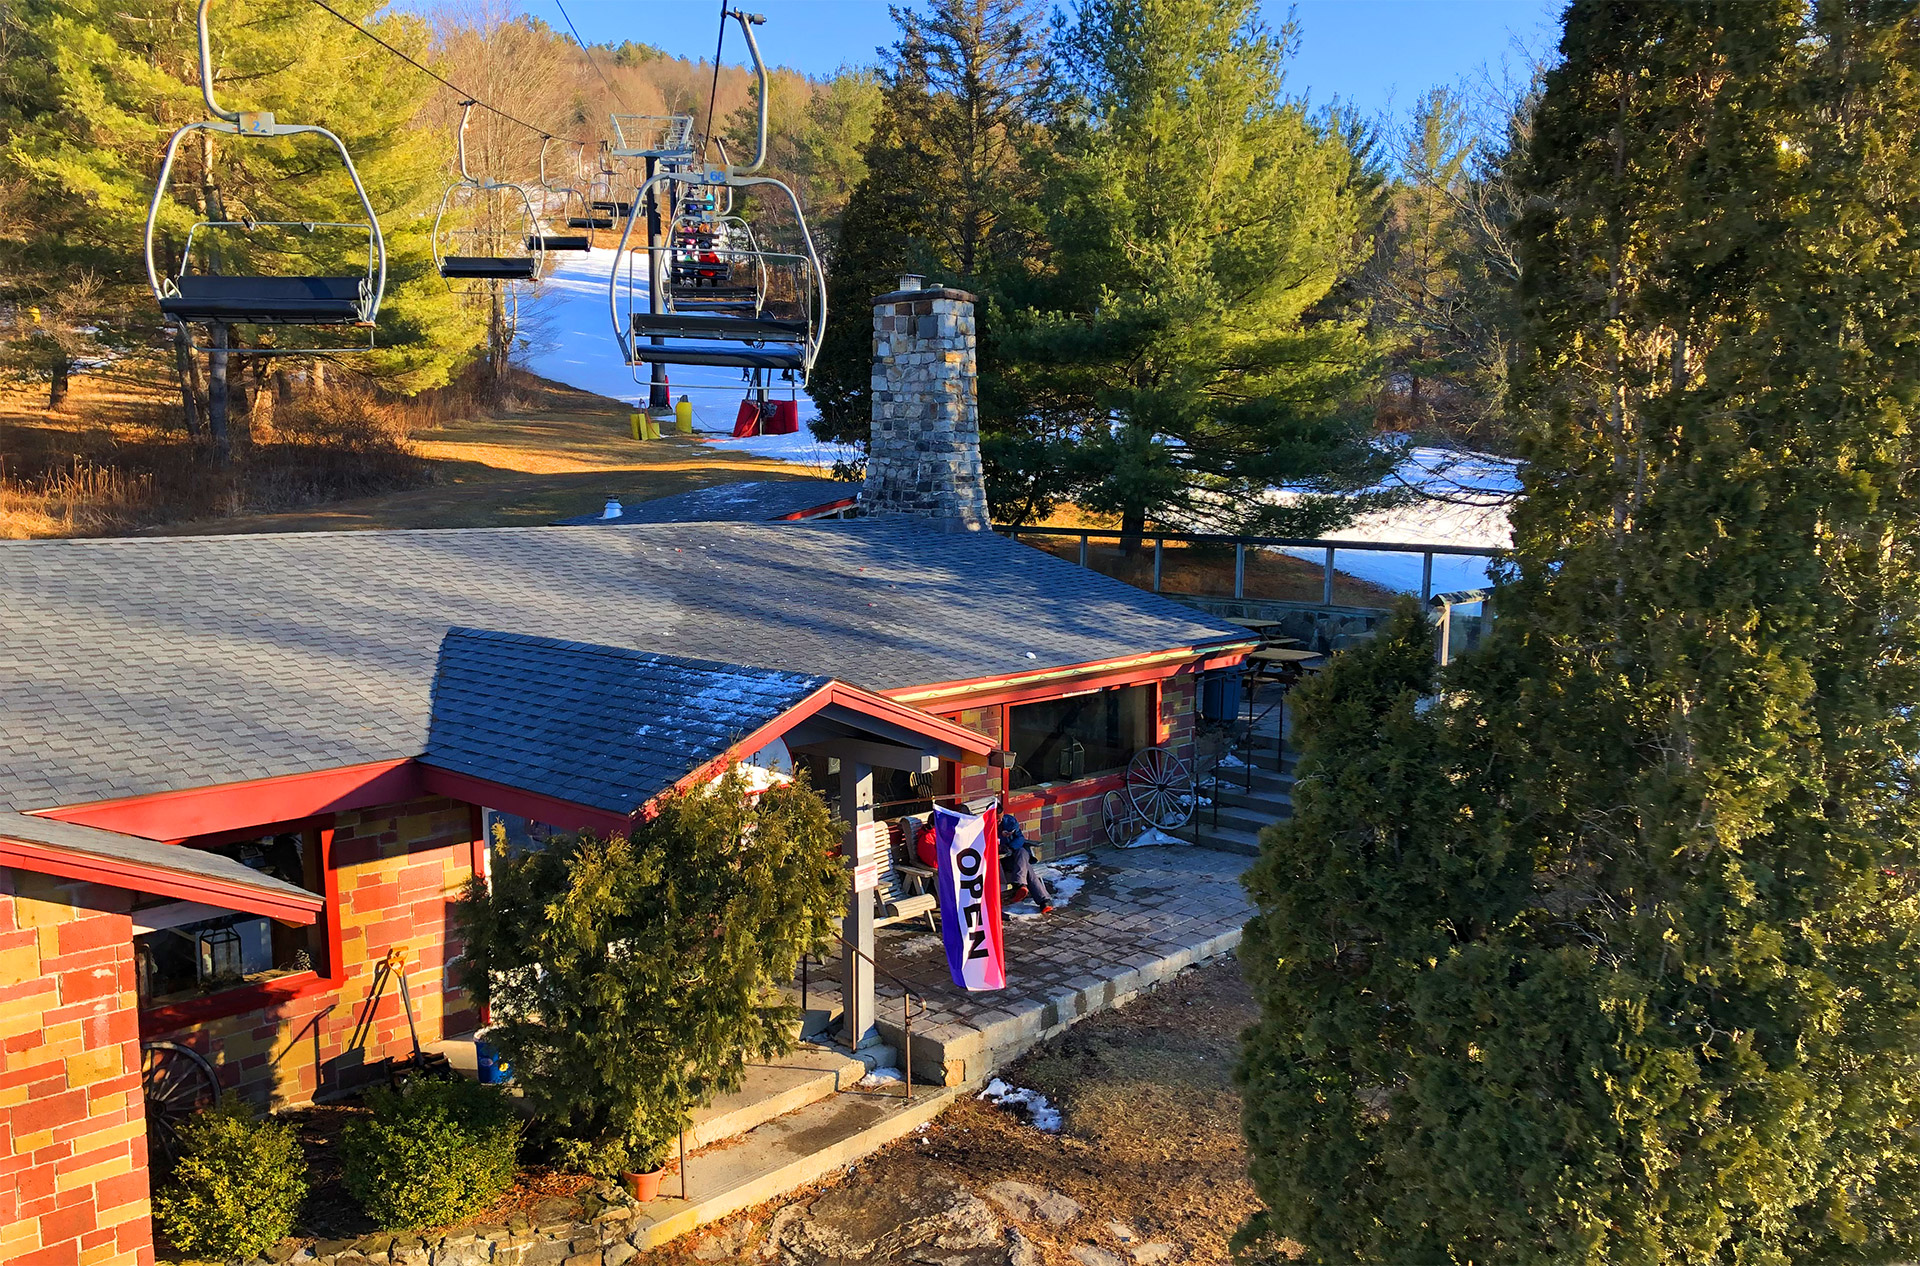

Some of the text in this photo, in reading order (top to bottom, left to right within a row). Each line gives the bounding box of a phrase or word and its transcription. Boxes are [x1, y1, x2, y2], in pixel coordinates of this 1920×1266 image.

[252, 120, 260, 132] 2
[710, 170, 726, 182] 68
[956, 847, 990, 960] OPEN
